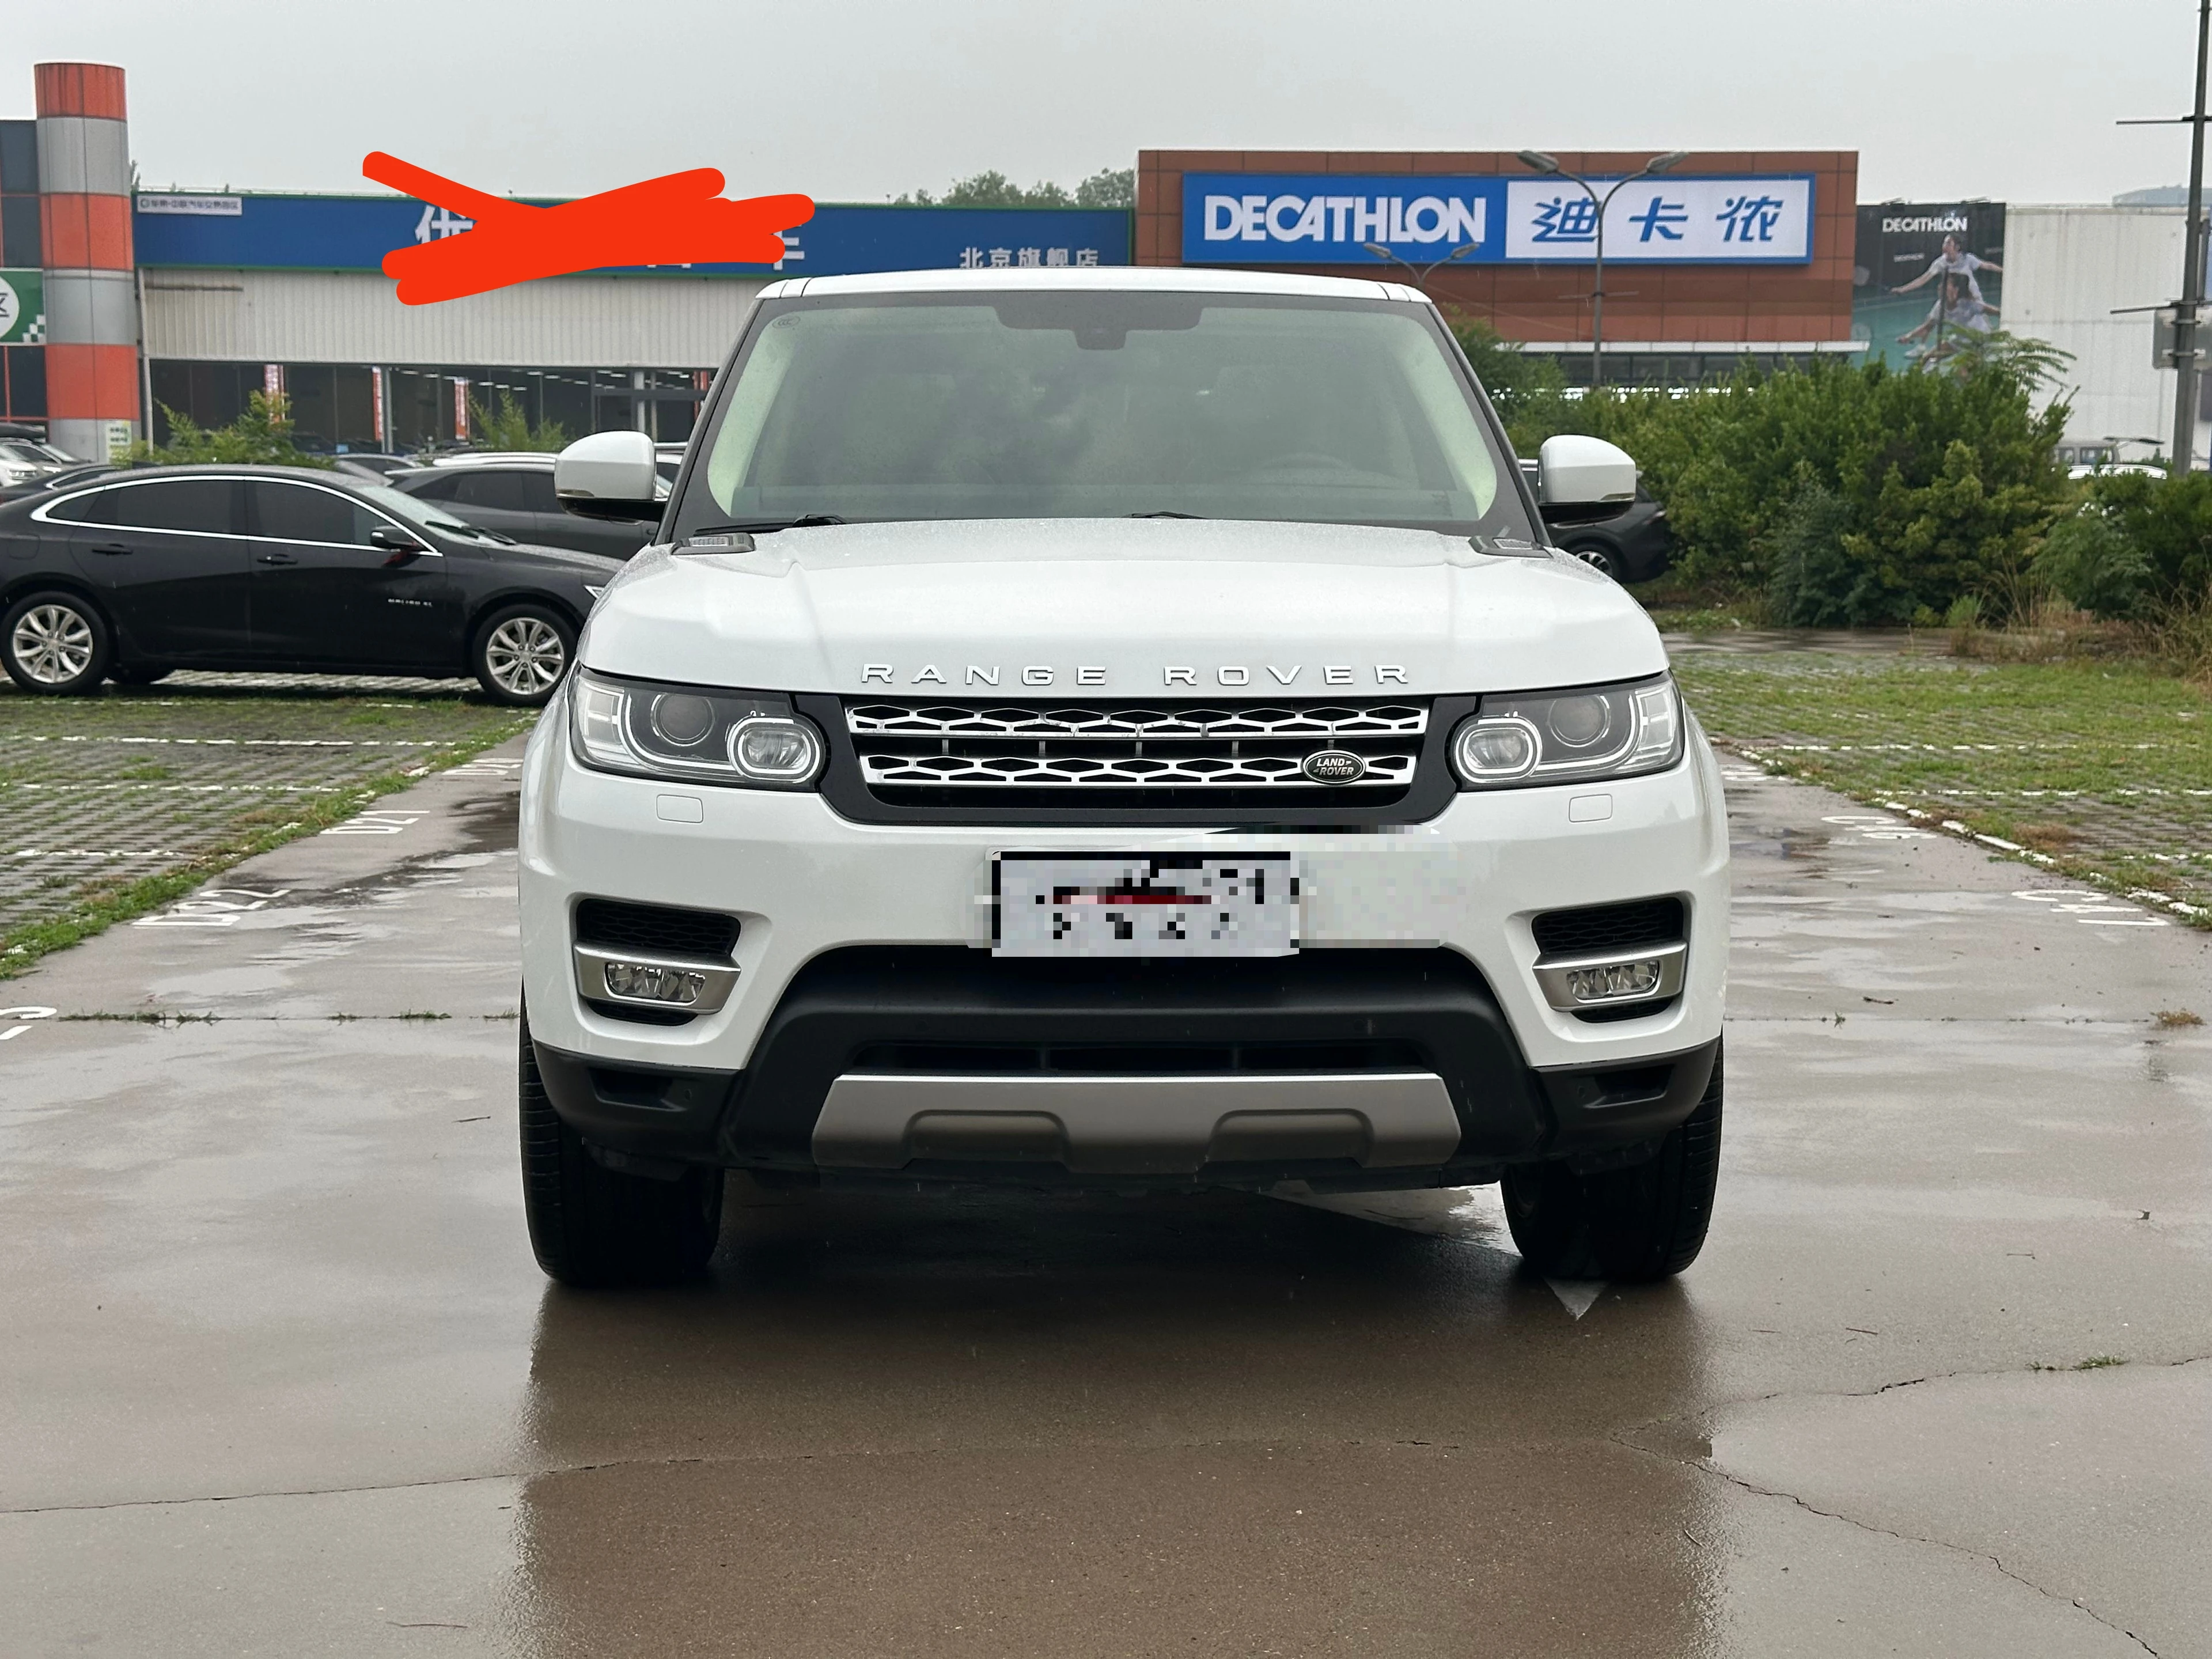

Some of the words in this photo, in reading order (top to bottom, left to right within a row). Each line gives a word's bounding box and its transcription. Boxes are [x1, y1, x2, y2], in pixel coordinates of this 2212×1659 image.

[1205, 195, 1487, 243] DECATHLON
[1531, 196, 1784, 243] 迪卡侬
[1882, 217, 1967, 233] DECATHLON
[960, 247, 1099, 268] 北京旗舰店
[861, 664, 1107, 685] RANGE
[1164, 664, 1408, 685] ROVER
[1316, 758, 1345, 767] LAND
[1319, 767, 1354, 775] ROVER
[320, 810, 430, 834] D21
[132, 889, 290, 926] D22
